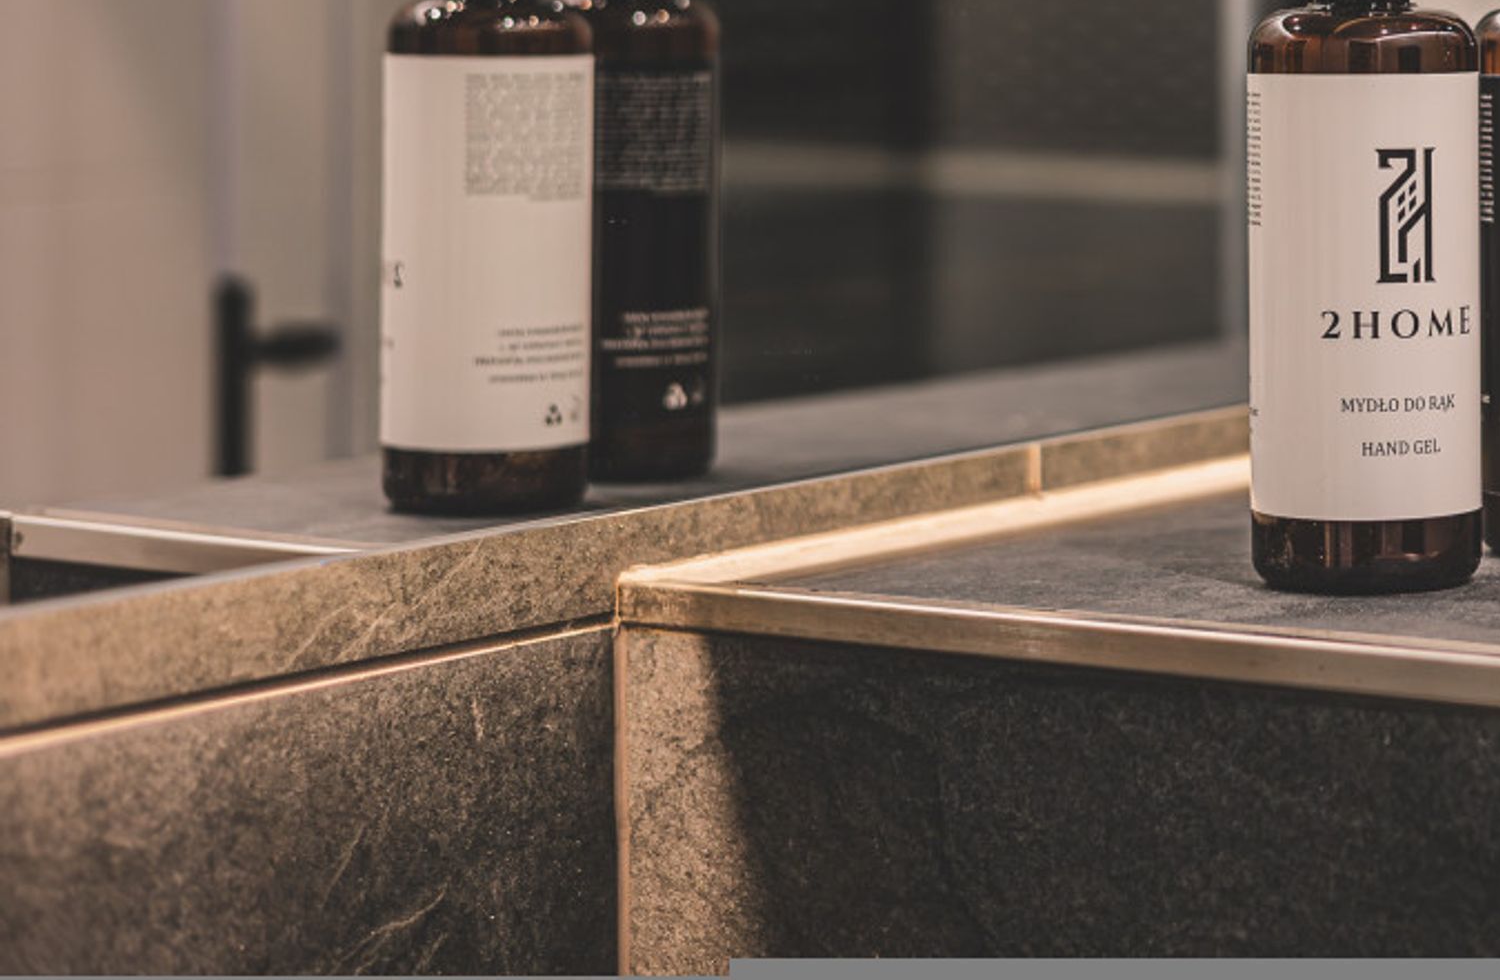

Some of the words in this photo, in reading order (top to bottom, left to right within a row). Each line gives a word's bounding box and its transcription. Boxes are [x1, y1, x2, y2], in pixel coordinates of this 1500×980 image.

[1320, 305, 1471, 339] 2HOME
[1340, 397, 1400, 413] MYDŁO
[1404, 396, 1426, 412] DO
[1429, 393, 1456, 412] RĄK
[1361, 440, 1410, 457] HAND
[1413, 438, 1441, 455] GEL
